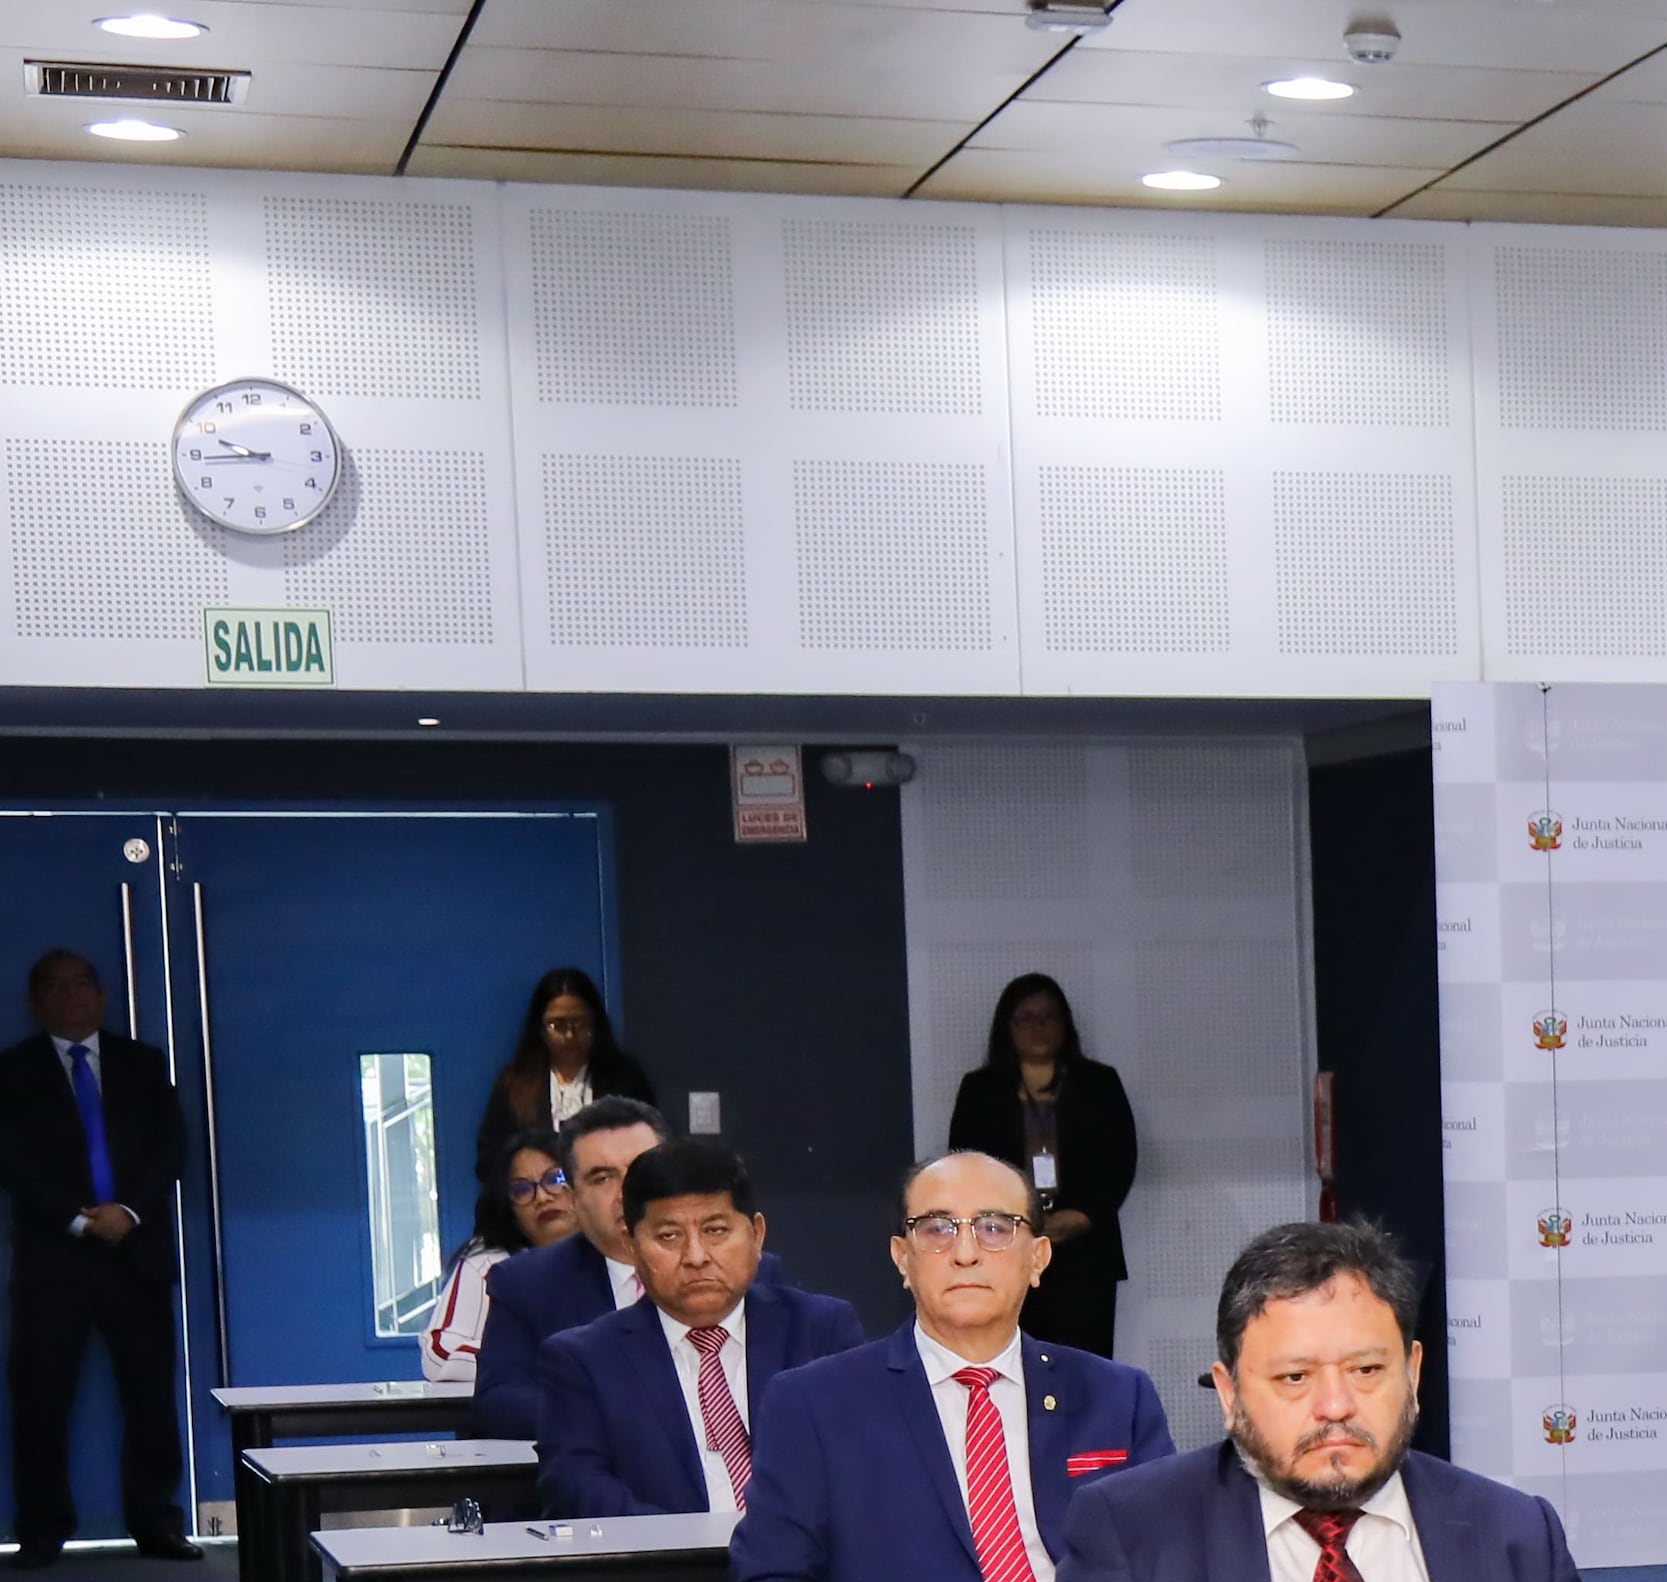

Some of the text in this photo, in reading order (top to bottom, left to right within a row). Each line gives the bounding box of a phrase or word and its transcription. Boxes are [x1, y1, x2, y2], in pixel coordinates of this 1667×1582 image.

[242, 393, 262, 406] 12
[216, 402, 233, 414] 11
[197, 422, 216, 434] 10
[300, 424, 312, 436] 2
[190, 450, 201, 461] 9
[310, 451, 322, 462] 3
[201, 477, 213, 489] 8
[304, 478, 316, 489] 4
[224, 498, 235, 509] 7
[283, 498, 295, 510] 5
[255, 507, 267, 519] 6
[213, 619, 325, 672] SALIDA
[1571, 816, 1612, 832] Junta
[1572, 834, 1643, 850] de Justicia
[1576, 1015, 1617, 1030] Junta
[1577, 1033, 1648, 1049] de Justicia
[1580, 1212, 1622, 1228] Junta
[1581, 1229, 1654, 1246] de Justicia
[1585, 1408, 1627, 1424] Junta
[1586, 1425, 1658, 1442] de Justicia
